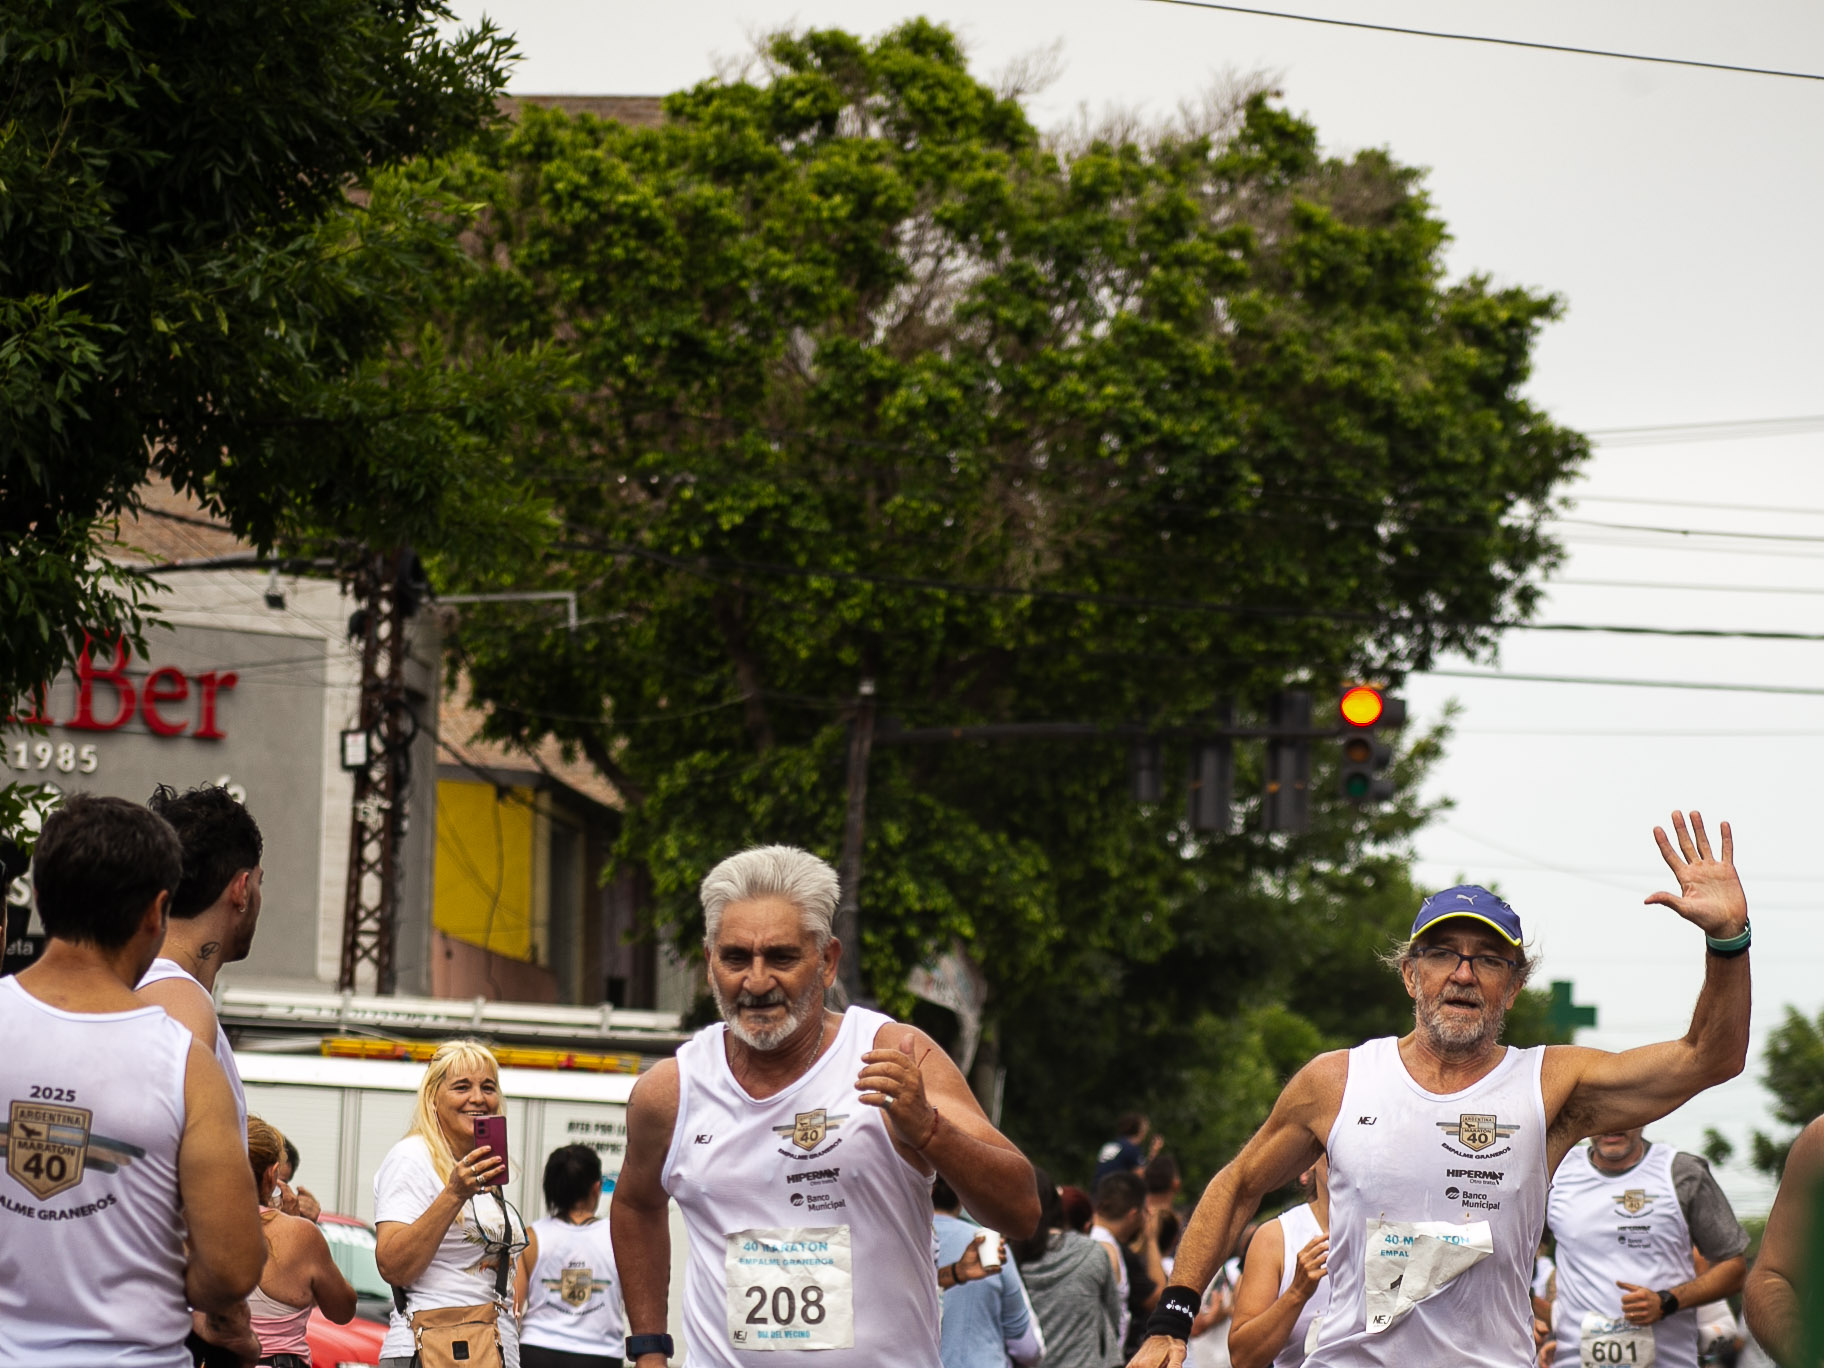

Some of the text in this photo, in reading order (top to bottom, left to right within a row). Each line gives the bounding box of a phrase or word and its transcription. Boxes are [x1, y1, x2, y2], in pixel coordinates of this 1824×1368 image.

[14, 741, 98, 773] 1985
[29, 1085, 77, 1102] 2025
[19, 1109, 81, 1126] ARGENTINA
[800, 1129, 819, 1143] 40
[1466, 1132, 1489, 1144] 40
[1441, 1142, 1512, 1159] EMPALME GRANEROS
[23, 1153, 67, 1182] 40
[807, 1194, 830, 1203] Banco
[1462, 1191, 1488, 1200] Banco
[0, 1193, 118, 1221] ALME GRANEROS
[808, 1199, 846, 1211] Municipal
[1462, 1200, 1501, 1211] Municipal
[743, 1241, 759, 1252] 40
[1384, 1234, 1399, 1246] 40
[1380, 1249, 1409, 1258] EMPAL
[567, 1290, 586, 1301] 40
[745, 1285, 826, 1326] 208
[1592, 1340, 1637, 1365] 601
